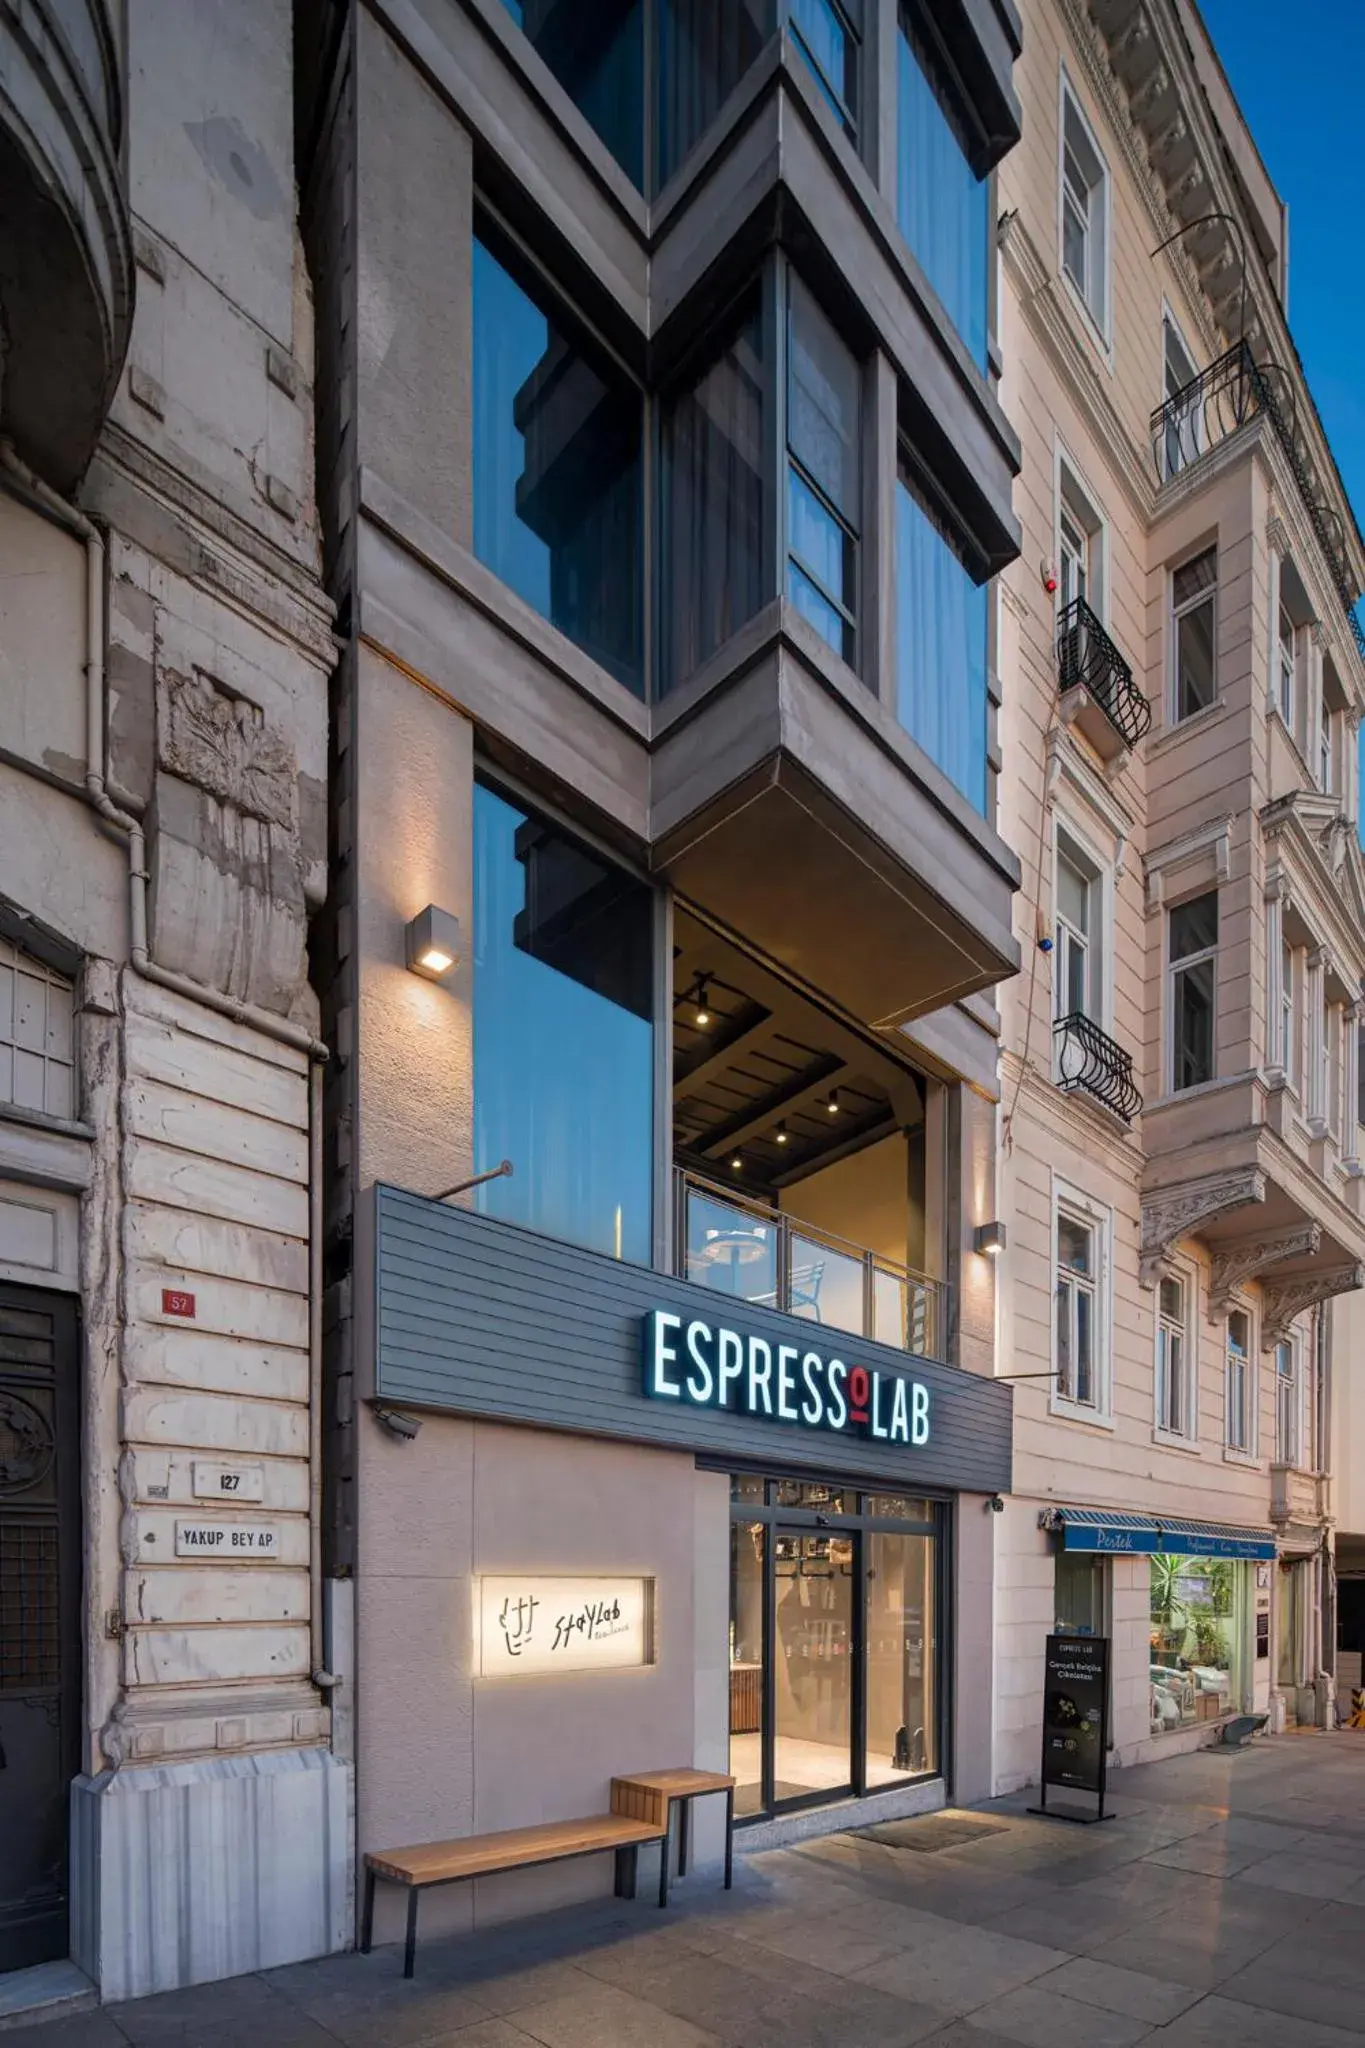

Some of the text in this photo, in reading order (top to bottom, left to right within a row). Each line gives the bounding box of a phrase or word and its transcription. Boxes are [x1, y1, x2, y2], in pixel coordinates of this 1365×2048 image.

[653, 1309, 930, 1446] ESPRESSOLAB
[220, 1475, 240, 1490] 127
[184, 1530, 273, 1547] YAKUP BEY AP
